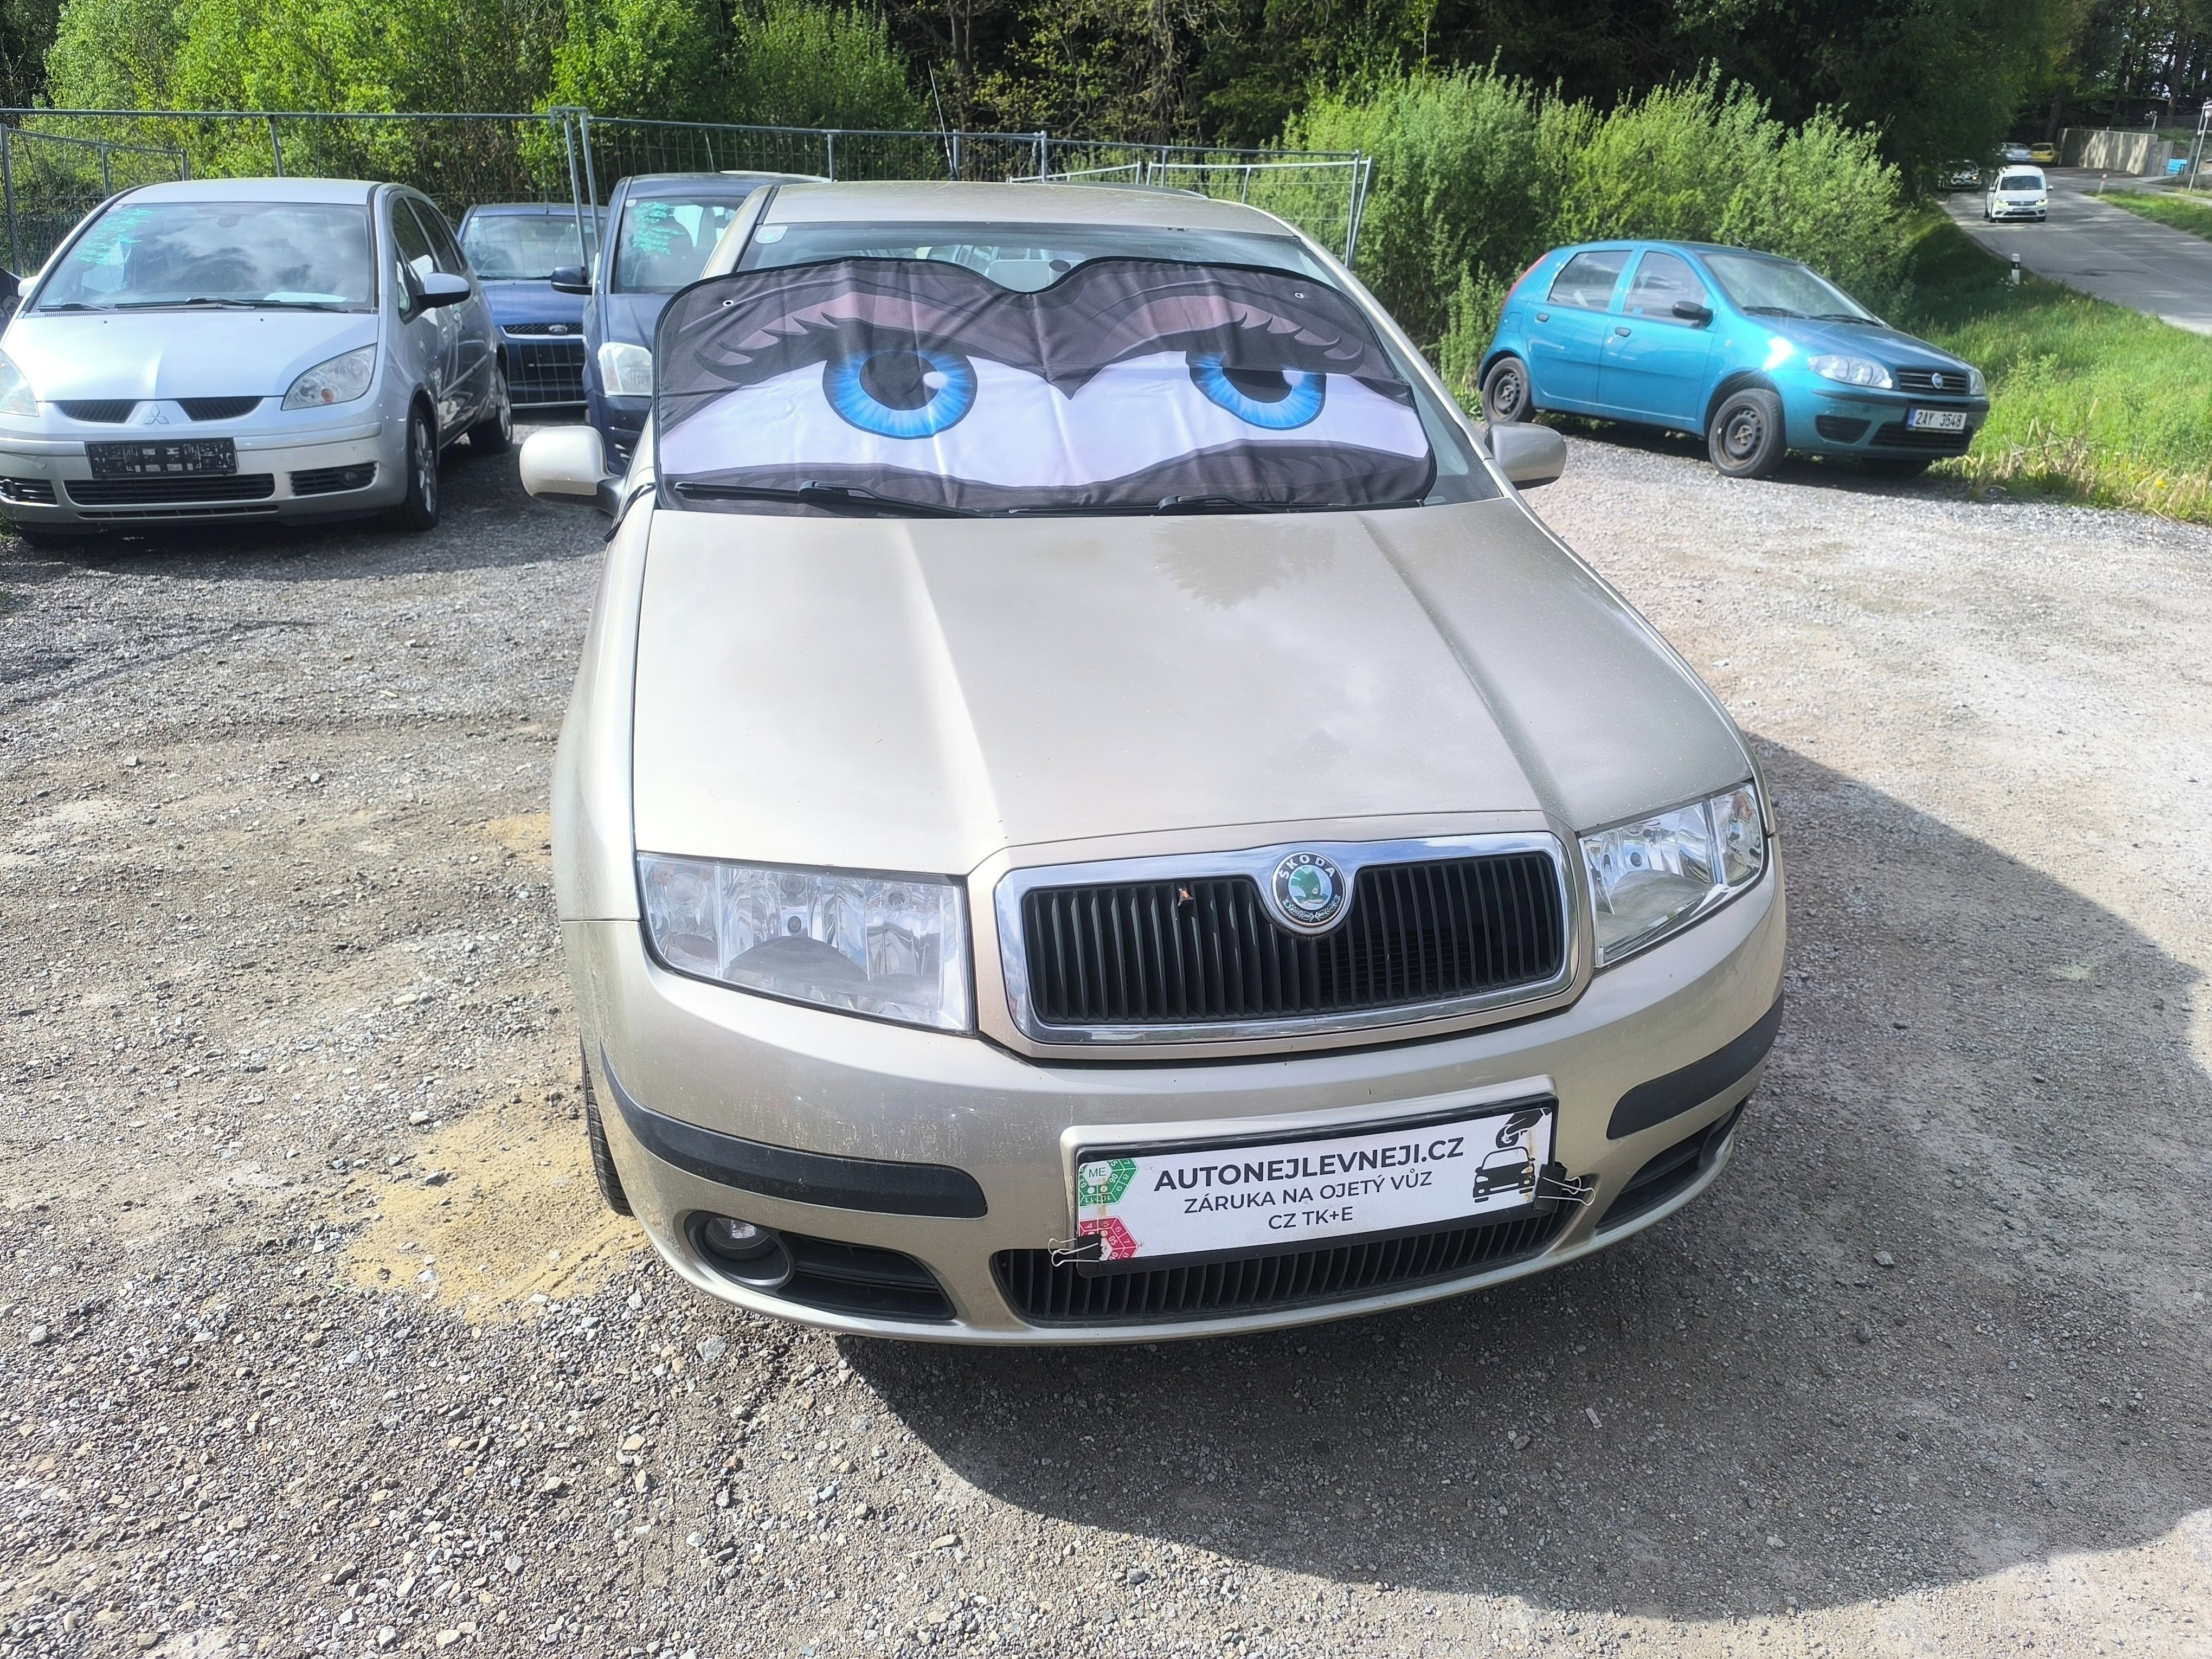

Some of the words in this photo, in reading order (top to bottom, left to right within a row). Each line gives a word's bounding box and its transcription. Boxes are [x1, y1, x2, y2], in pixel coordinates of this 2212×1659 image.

[1915, 411, 1935, 426] 2AY
[1278, 854, 1336, 880] ŠKODA
[1089, 1167, 1107, 1178] ME
[1153, 1136, 1464, 1192] AUTONEJLEVNEJI.CZ
[1184, 1193, 1276, 1214] ZÁRUKA
[1282, 1187, 1314, 1204] NA
[1319, 1174, 1386, 1200] OJETÝ
[1390, 1168, 1433, 1190] VŮZ
[1268, 1212, 1297, 1230] CZ
[1301, 1206, 1353, 1226] TK+E
[1108, 1236, 1118, 1245] 05
